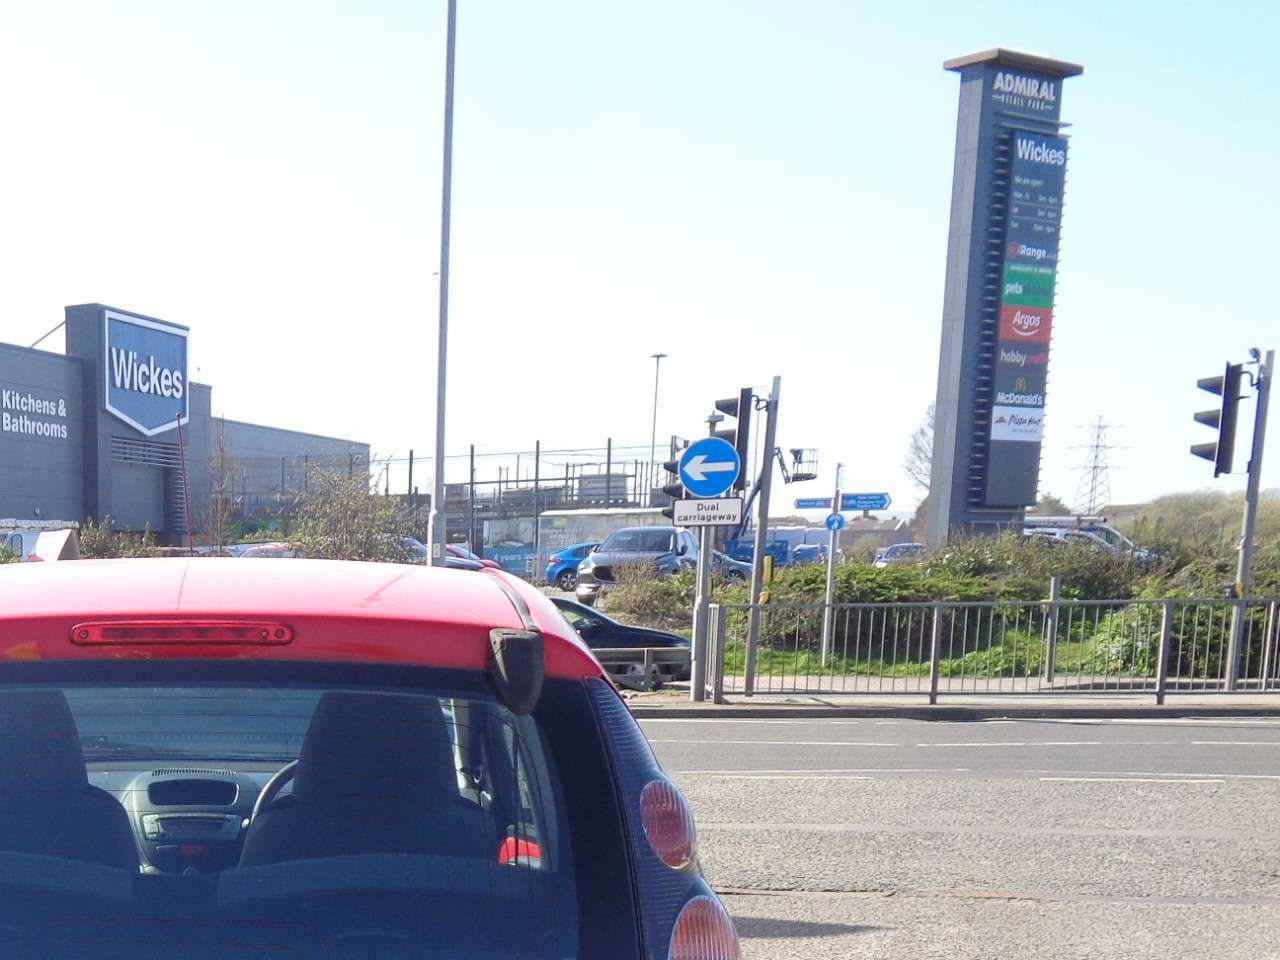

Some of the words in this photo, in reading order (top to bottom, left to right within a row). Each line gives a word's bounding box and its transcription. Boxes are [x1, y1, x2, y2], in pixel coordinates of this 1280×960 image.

[992, 72, 1056, 101] ADMIRAL
[1017, 138, 1065, 166] Wickes
[1012, 310, 1040, 330] Argos
[111, 346, 184, 399] Wickes
[2, 389, 57, 416] Kitchens
[58, 399, 67, 417] &
[2, 412, 68, 439] Bathrooms
[677, 513, 737, 522] carriageway
[696, 503, 719, 511] Dual
